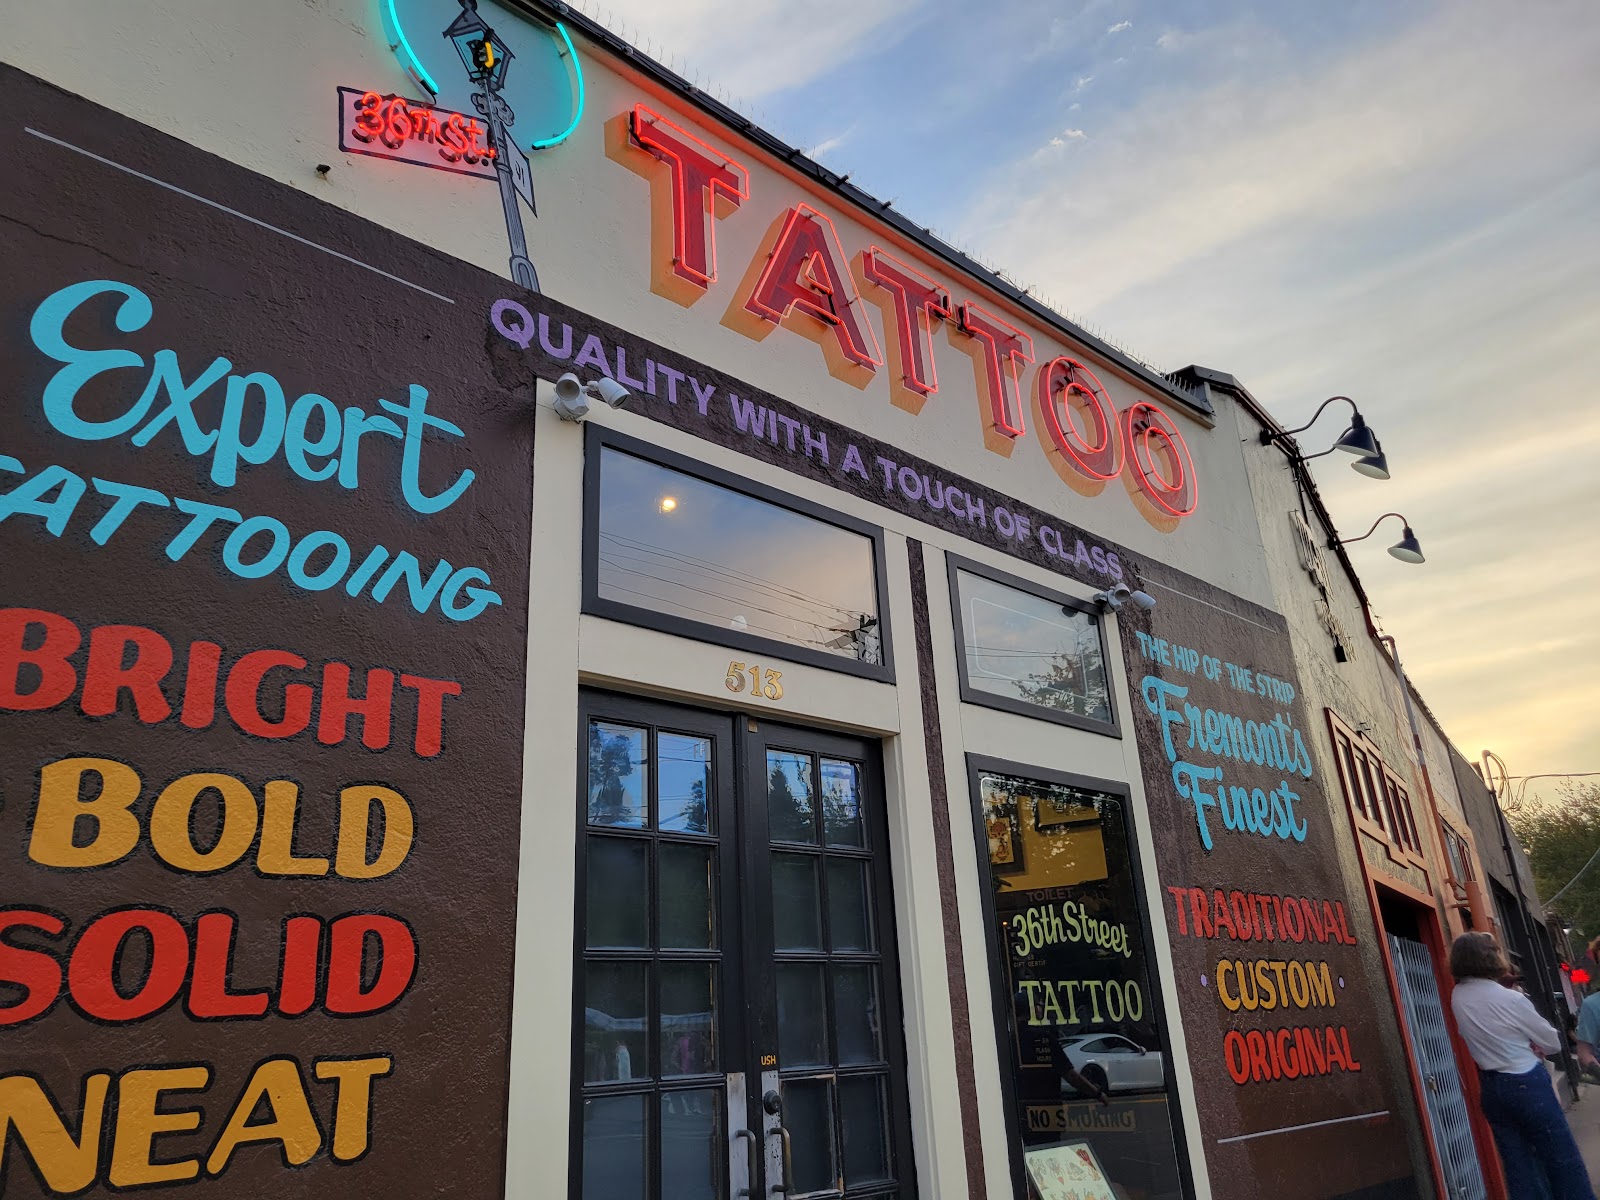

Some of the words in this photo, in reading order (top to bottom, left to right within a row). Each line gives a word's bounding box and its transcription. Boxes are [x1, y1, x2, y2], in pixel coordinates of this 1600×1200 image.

[616, 102, 1199, 522] TATTOO
[30, 279, 475, 514] Expert
[490, 298, 717, 417] QUALITY
[729, 392, 830, 465] WITH
[842, 444, 869, 481] A
[877, 455, 986, 528] TOUCH
[993, 506, 1031, 542] OF
[1039, 525, 1123, 580] CLASS
[0, 607, 461, 757] BRIGHT
[725, 661, 784, 701] 513
[1136, 631, 1172, 667] THE
[1173, 644, 1199, 674] HIP
[1202, 655, 1222, 682] OF
[1224, 662, 1255, 694] THE
[1256, 673, 1295, 704] STRIP
[1142, 675, 1313, 778] Fremont's
[28, 757, 415, 879] BOLD
[1172, 760, 1307, 850] Finest
[1026, 888, 1074, 902] TOILET
[1167, 886, 1357, 945] TRADITIONAL
[0, 910, 417, 1025] SOLID
[1018, 979, 1143, 1026] TATTOO
[1216, 959, 1336, 1011] CUSTOM
[1224, 1026, 1361, 1085] ORIGINAL
[0, 1057, 391, 1193] NEAT
[1030, 1109, 1050, 1128] NO
[1056, 1109, 1132, 1127] SMOKING
